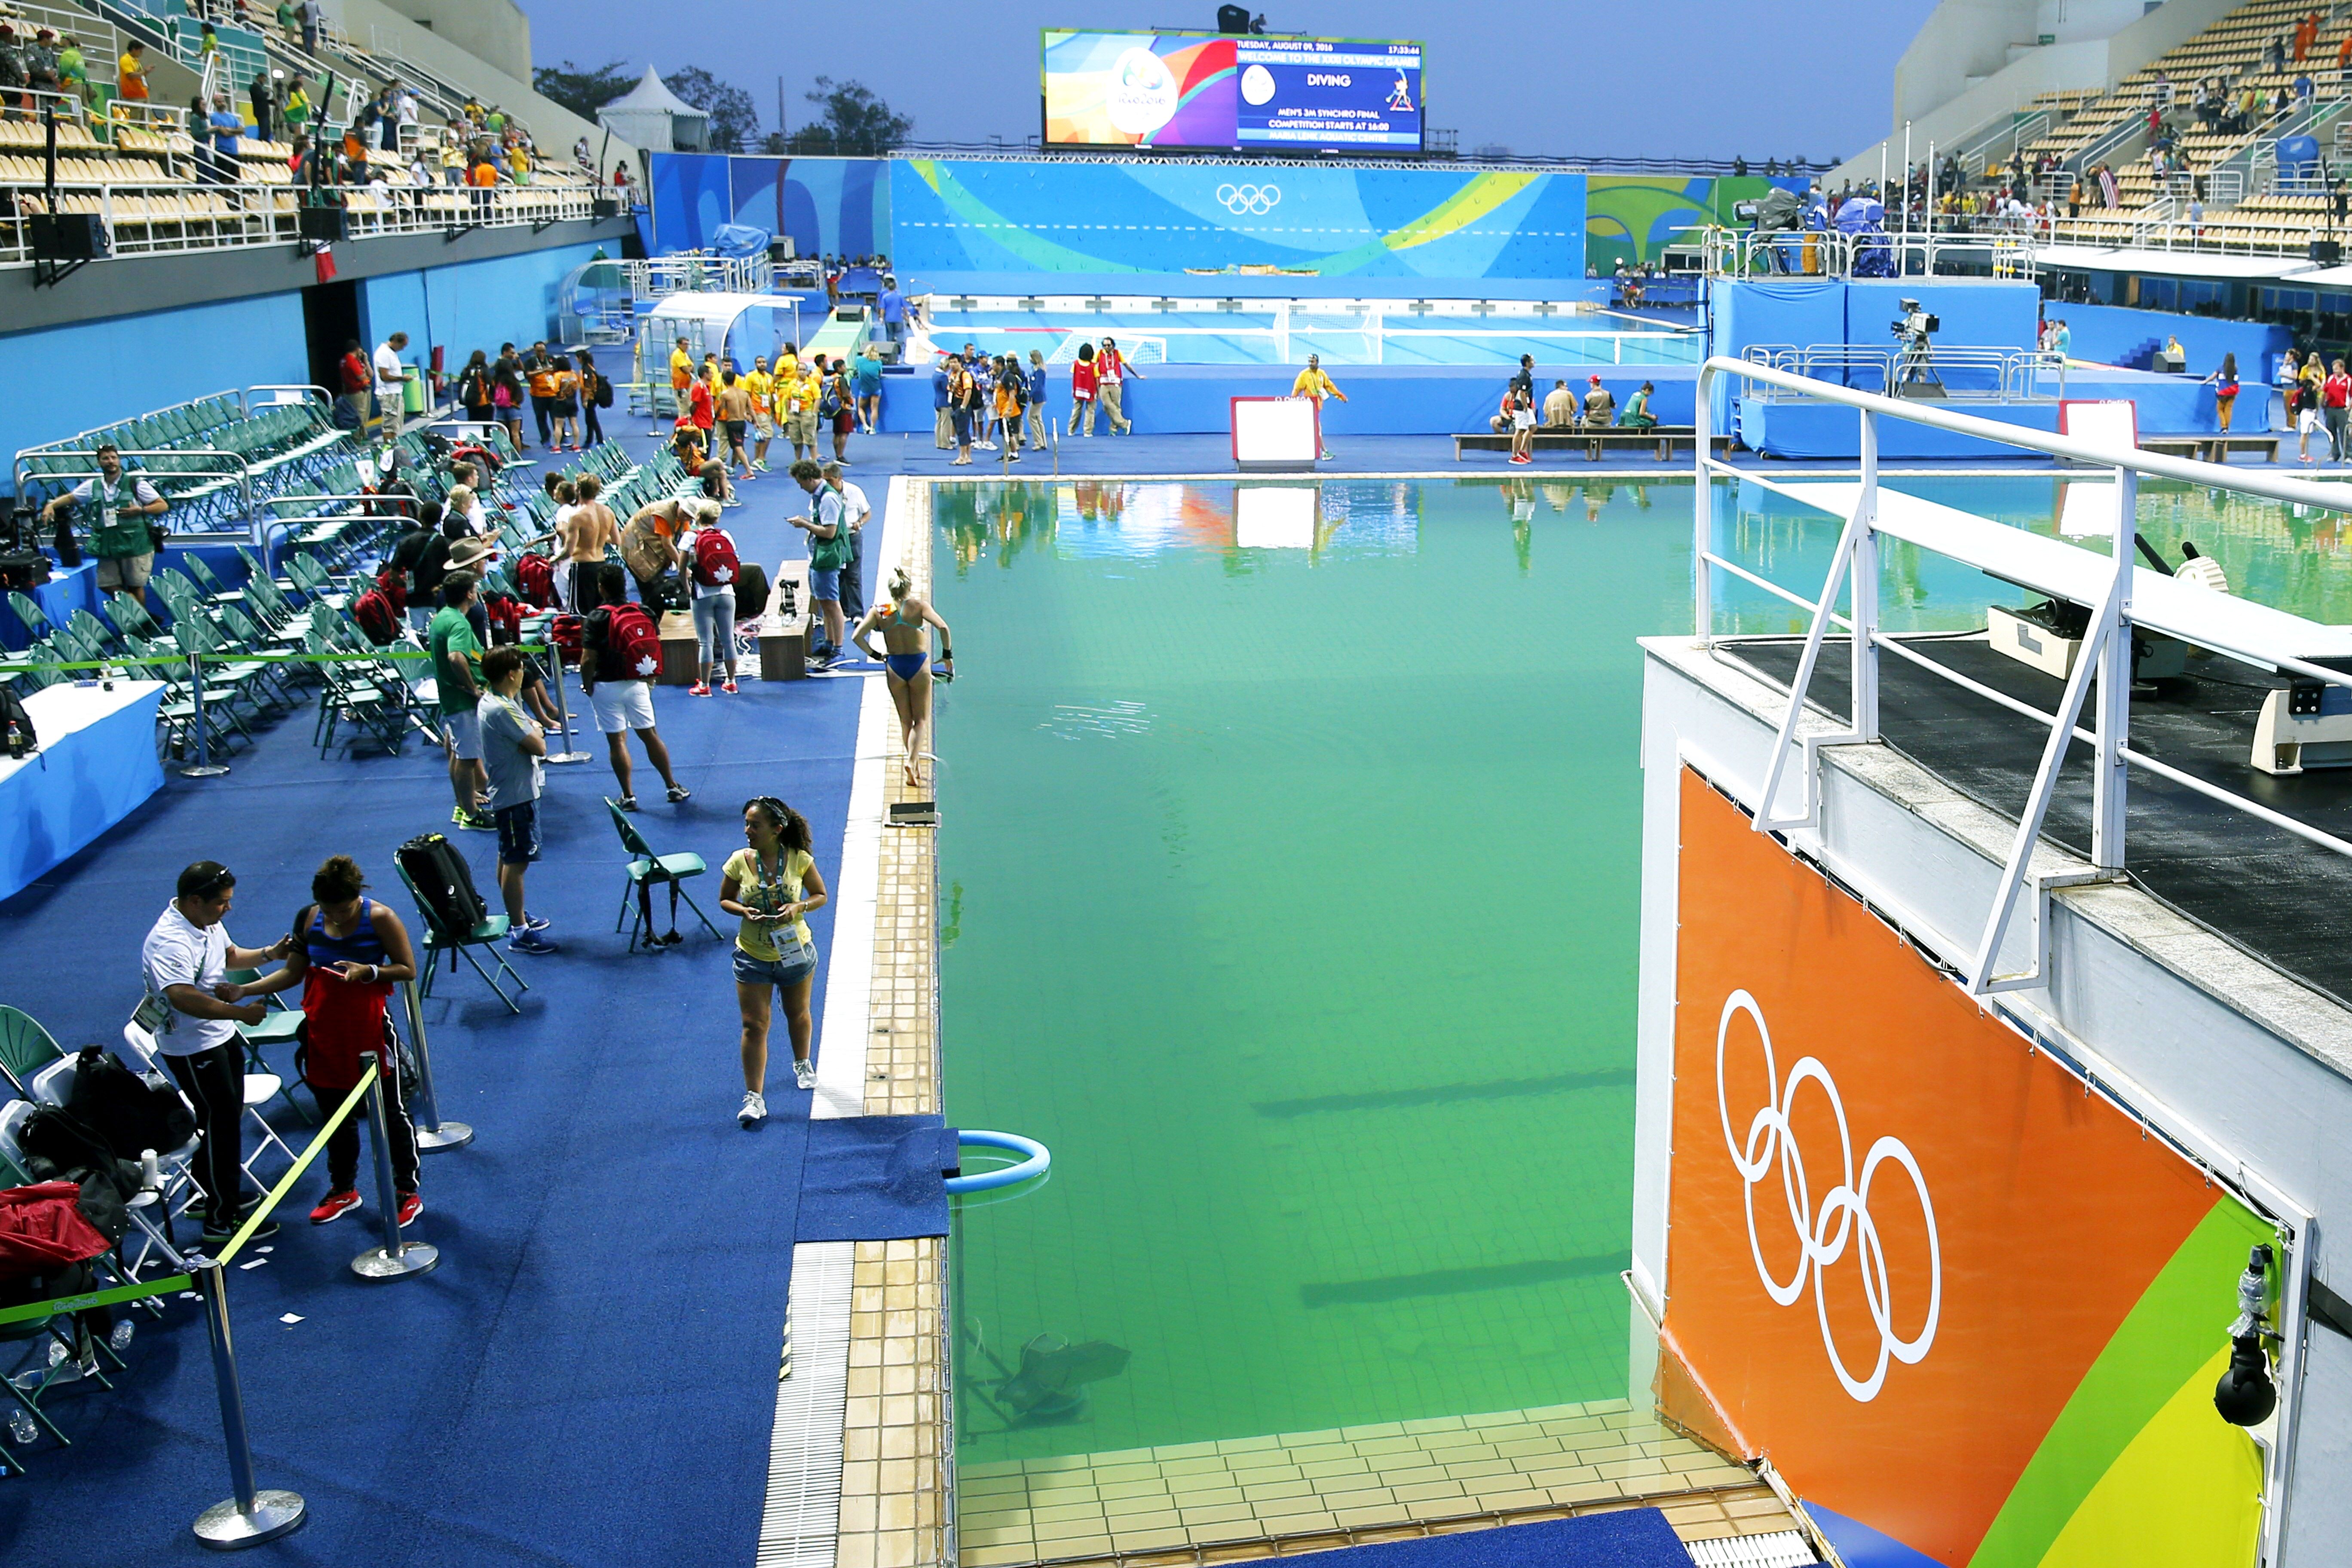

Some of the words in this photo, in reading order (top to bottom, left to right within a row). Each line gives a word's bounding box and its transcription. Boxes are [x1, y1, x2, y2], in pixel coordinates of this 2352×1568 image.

[1237, 40, 1271, 50] TUESDAY,
[1272, 42, 1302, 50] AUGUST
[1303, 42, 1314, 52] 09,
[1316, 43, 1333, 52] 2016
[1239, 52, 1286, 62] WELCOME
[1289, 53, 1302, 63] TO
[1304, 54, 1320, 64] THE
[1323, 55, 1341, 64] XXXI
[1343, 55, 1384, 66] OLYMPIC
[1385, 57, 1418, 67] GAMES
[1307, 73, 1351, 87] DIVING
[1278, 108, 1302, 117] MEN'S
[1304, 109, 1316, 117] 3M
[1318, 109, 1356, 118] SYNCHRO
[1357, 110, 1380, 119] FINAL
[1268, 119, 1324, 129] COMPETITION
[1325, 121, 1354, 130] STARTS
[1355, 122, 1367, 130] AT
[1368, 122, 1390, 131] 16:00
[1269, 132, 1297, 140] MARIA
[1298, 132, 1318, 141] LENK
[1319, 133, 1356, 141] AQUATIC
[1357, 134, 1388, 142] CENTRE
